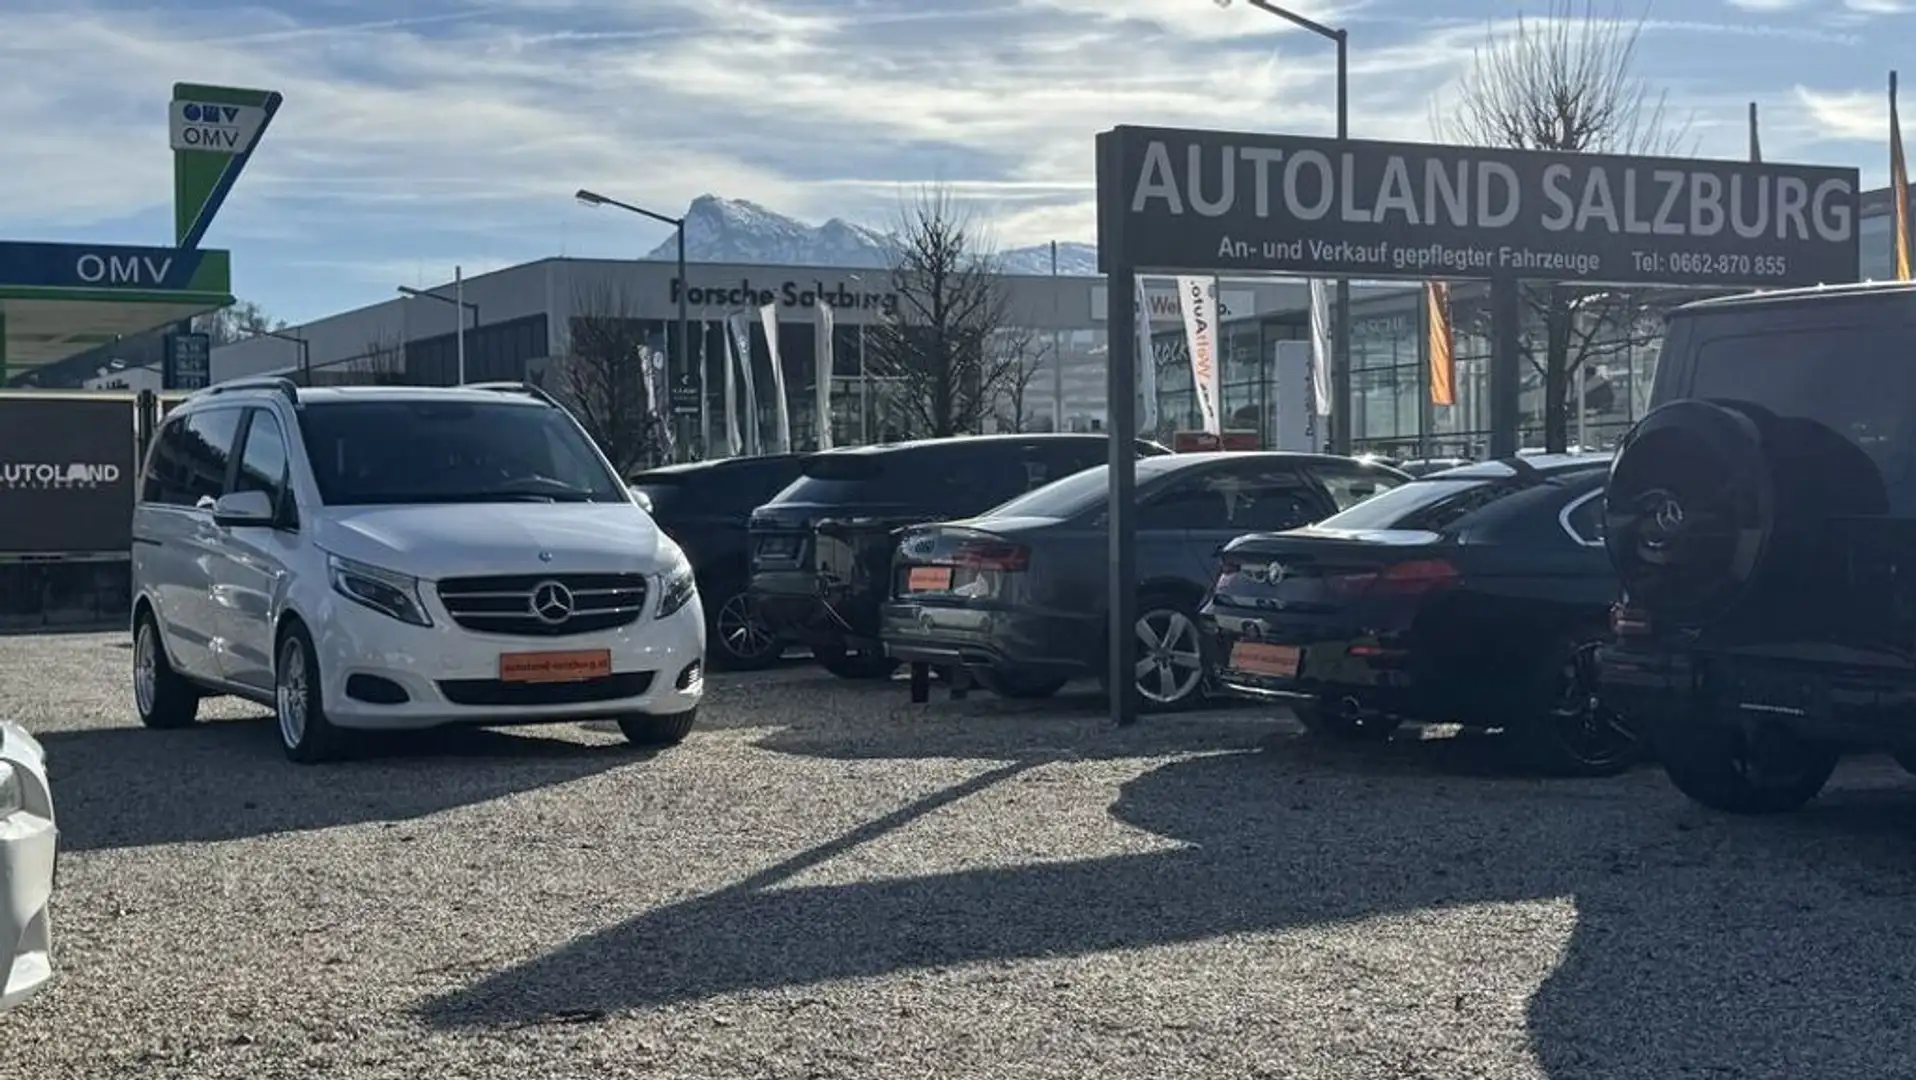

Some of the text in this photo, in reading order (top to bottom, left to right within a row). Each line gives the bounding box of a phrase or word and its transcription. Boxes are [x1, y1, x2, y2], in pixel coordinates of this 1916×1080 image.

[183, 127, 239, 147] OMV
[1132, 141, 1851, 242] AUTOLAND SALZBURG
[77, 254, 172, 284] OMV
[1218, 236, 1786, 276] An- und Verkauf gepflegter Fahrzeuge Tel: 0662-870 855
[669, 277, 774, 307] Porsche
